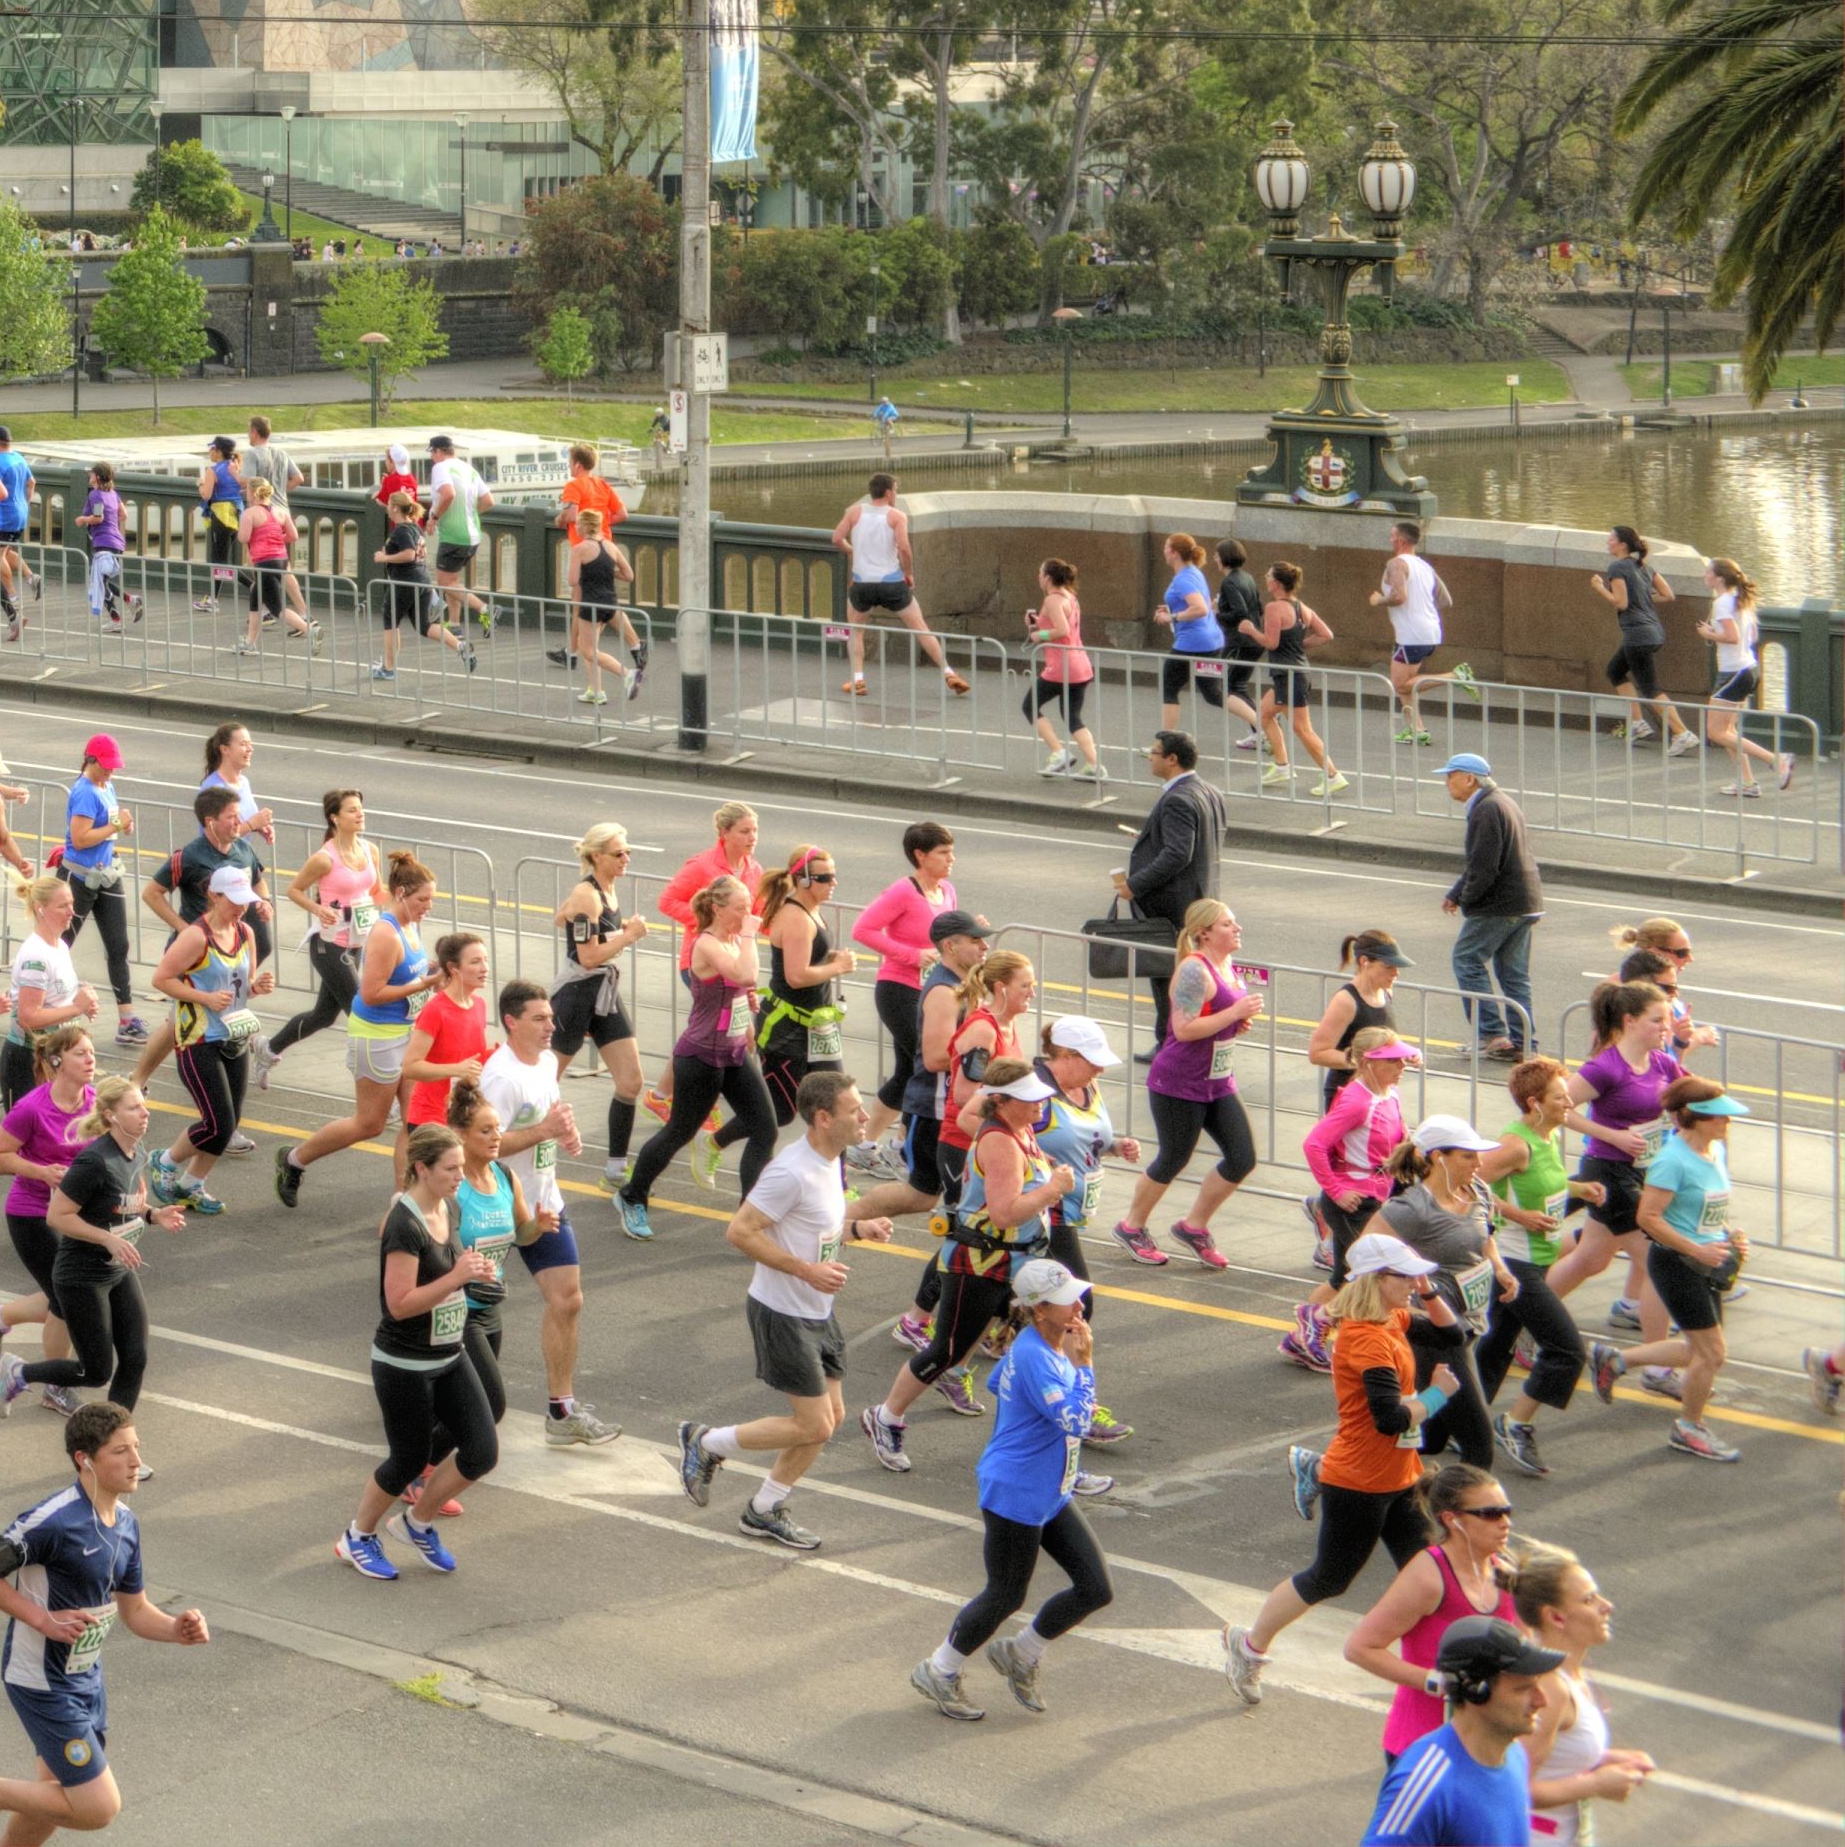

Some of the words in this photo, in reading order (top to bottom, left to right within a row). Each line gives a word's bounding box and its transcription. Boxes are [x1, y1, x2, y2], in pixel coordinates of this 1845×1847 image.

[501, 465, 516, 474] CITY
[518, 464, 538, 473] RIVER
[541, 462, 568, 472] CRUISES
